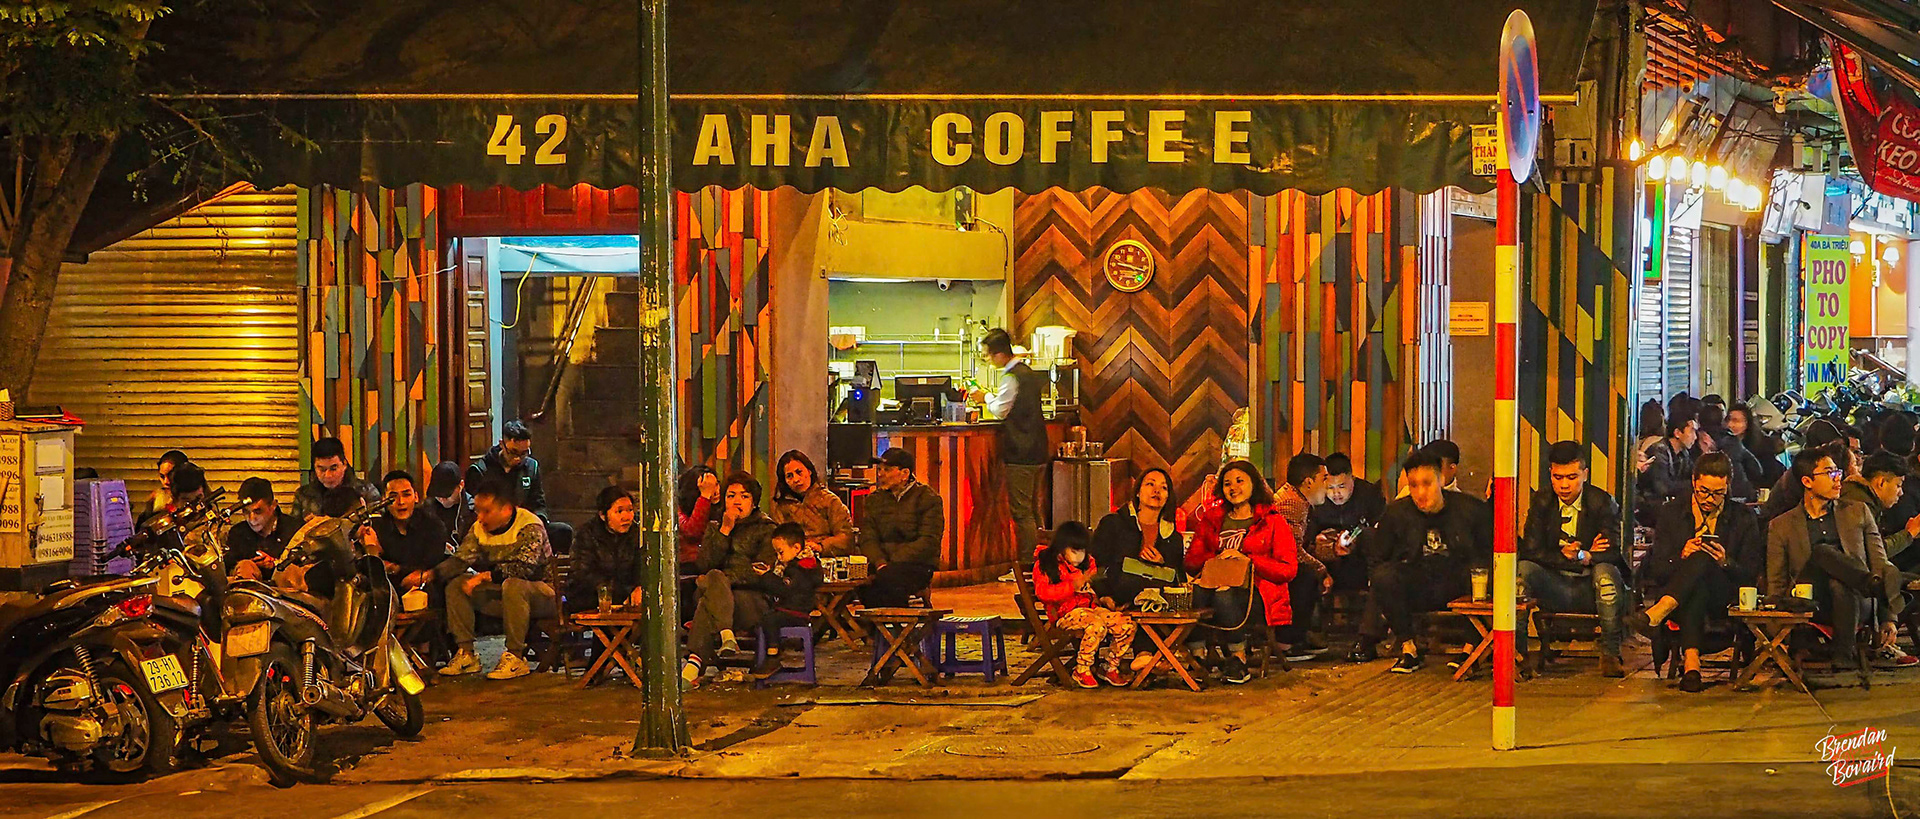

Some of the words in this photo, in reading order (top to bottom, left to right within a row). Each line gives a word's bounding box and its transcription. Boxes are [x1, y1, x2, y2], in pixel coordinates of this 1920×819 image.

[486, 113, 568, 165] 42
[692, 113, 851, 168] AHA
[930, 109, 1252, 167] COFFEE
[1812, 260, 1846, 284] PHO
[1817, 293, 1839, 317] TO
[1808, 325, 1847, 349] COPY
[1807, 363, 1818, 382] IN
[147, 657, 176, 675] 29-H1
[150, 671, 186, 691] 736.12
